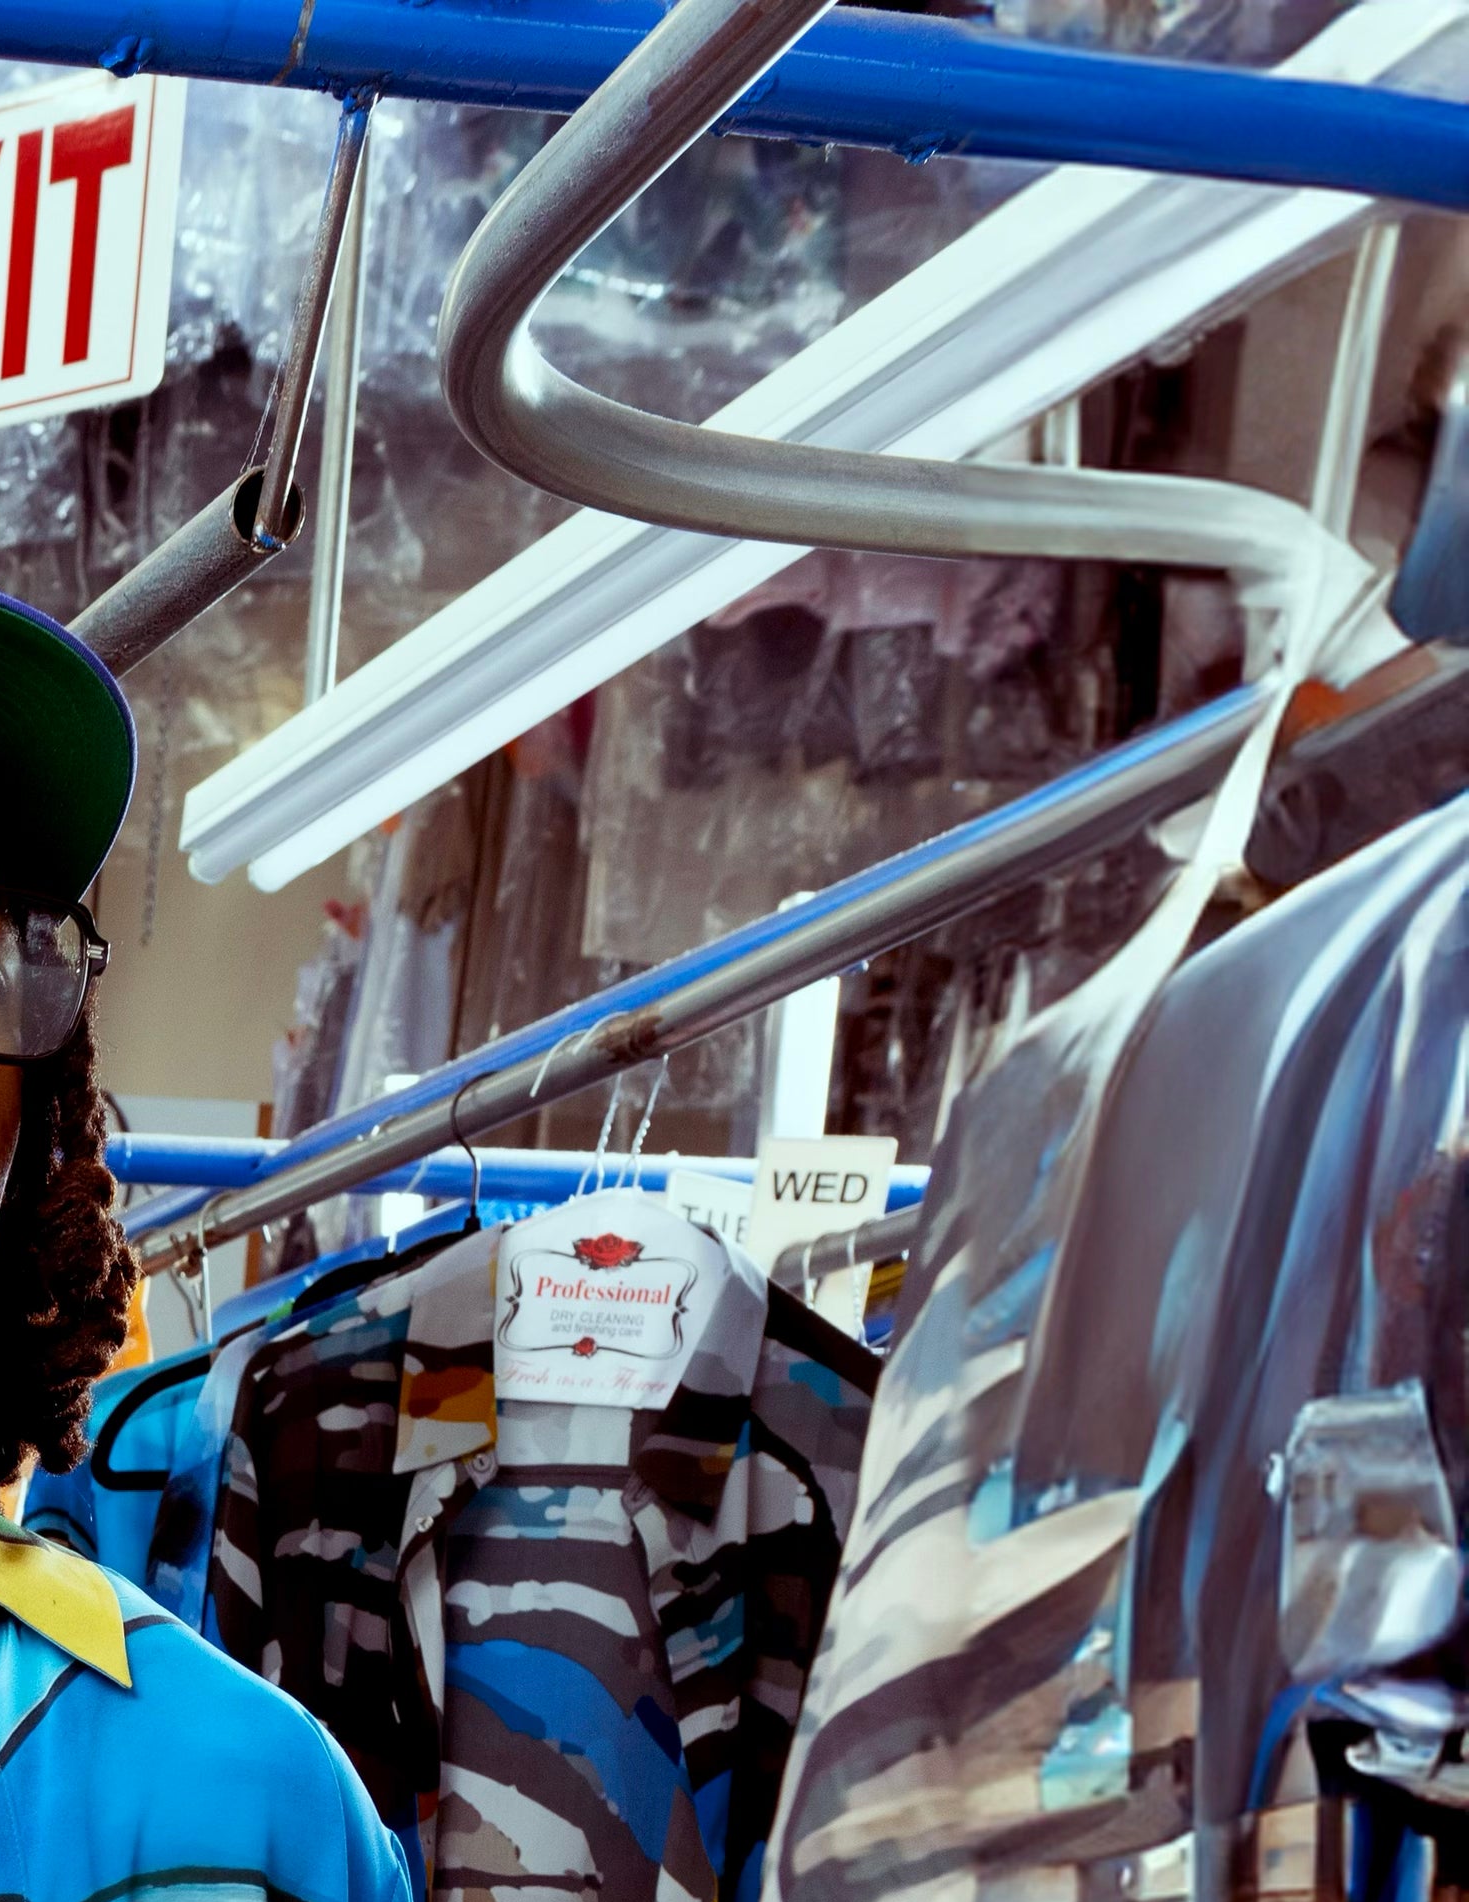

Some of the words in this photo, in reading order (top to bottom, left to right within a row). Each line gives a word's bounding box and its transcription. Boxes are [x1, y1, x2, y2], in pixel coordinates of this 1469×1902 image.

[773, 1170, 869, 1204] WED
[535, 1275, 671, 1305] Professional
[550, 1309, 575, 1322] DRY
[579, 1311, 645, 1326] CLEANING
[551, 1322, 571, 1334] and
